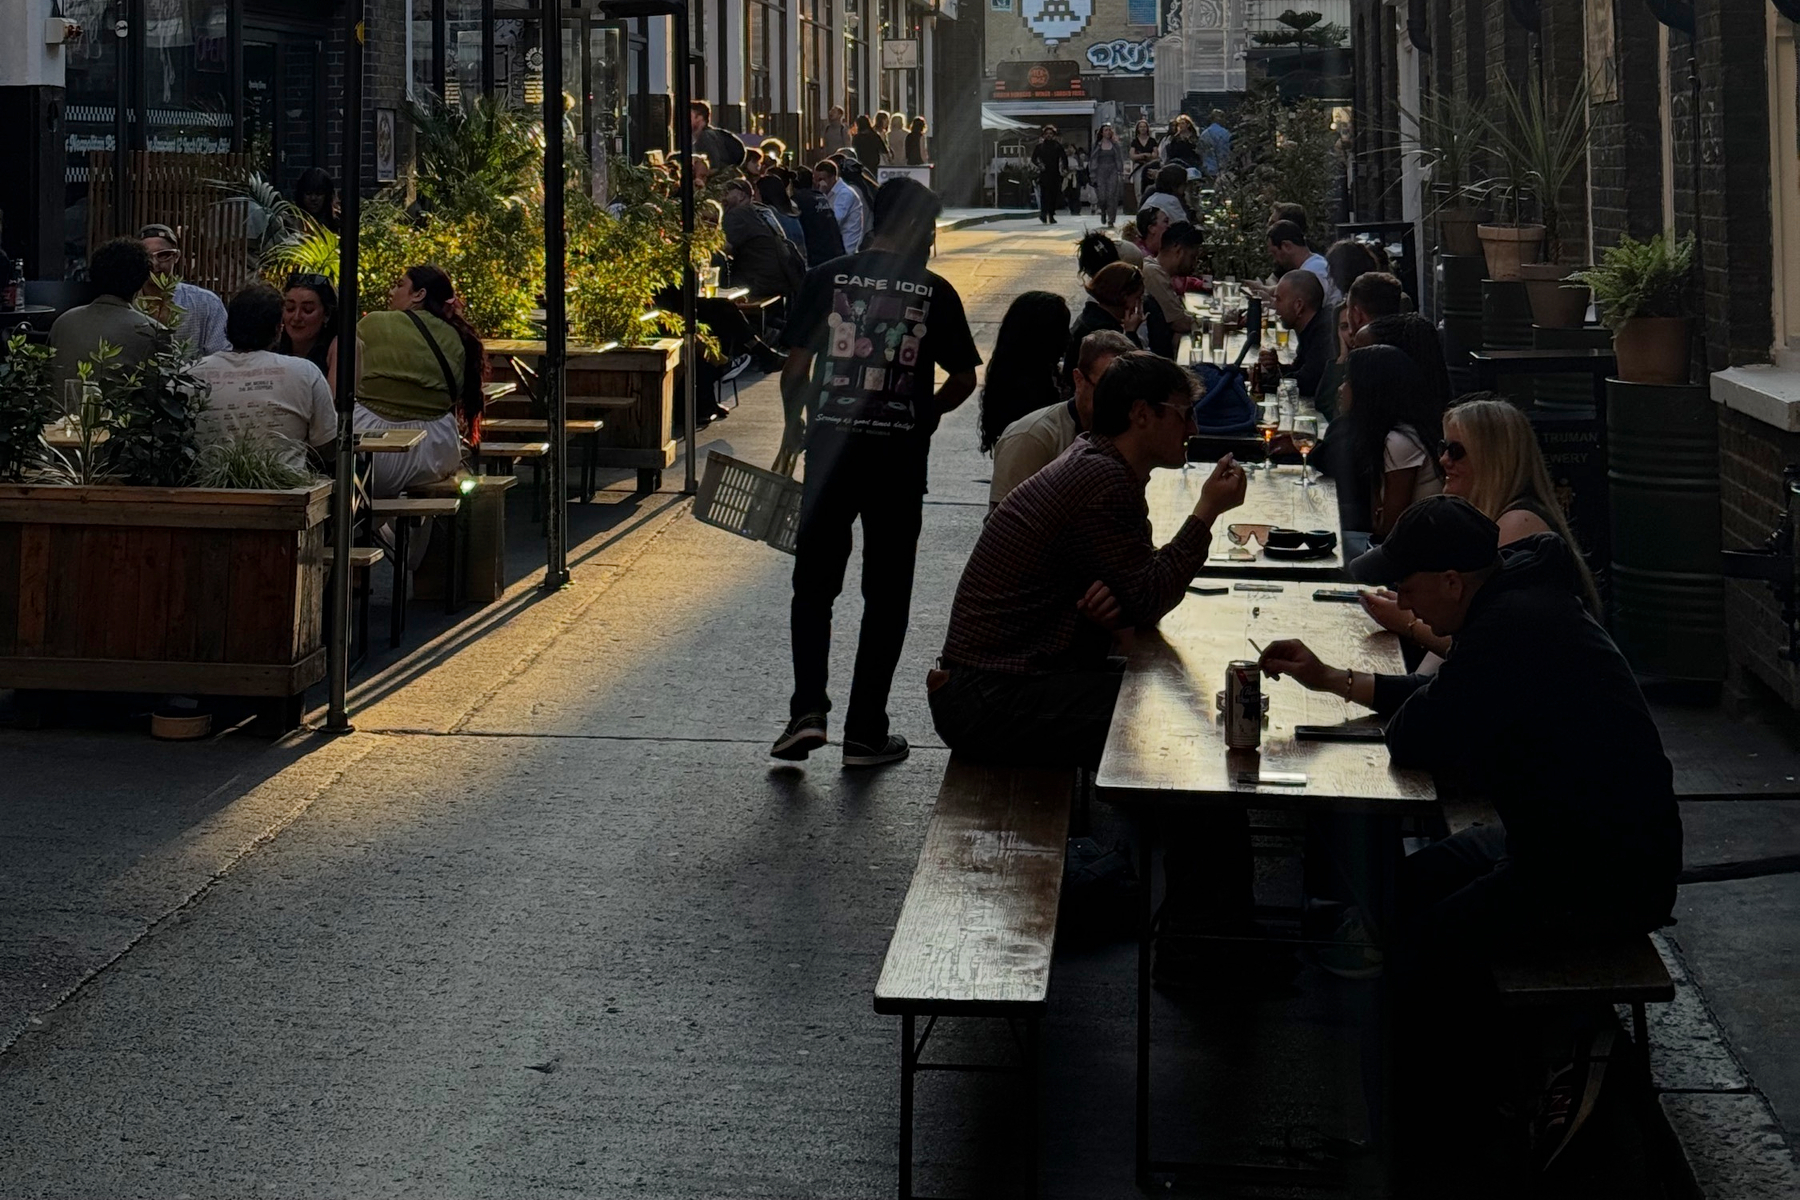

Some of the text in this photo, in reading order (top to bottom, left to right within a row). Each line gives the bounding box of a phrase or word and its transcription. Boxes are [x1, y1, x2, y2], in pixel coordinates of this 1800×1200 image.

[834, 274, 933, 297] CAFE 1001
[815, 413, 841, 426] Serving
[852, 418, 871, 426] good
[872, 419, 891, 427] times
[1543, 432, 1598, 442] TRUMAN
